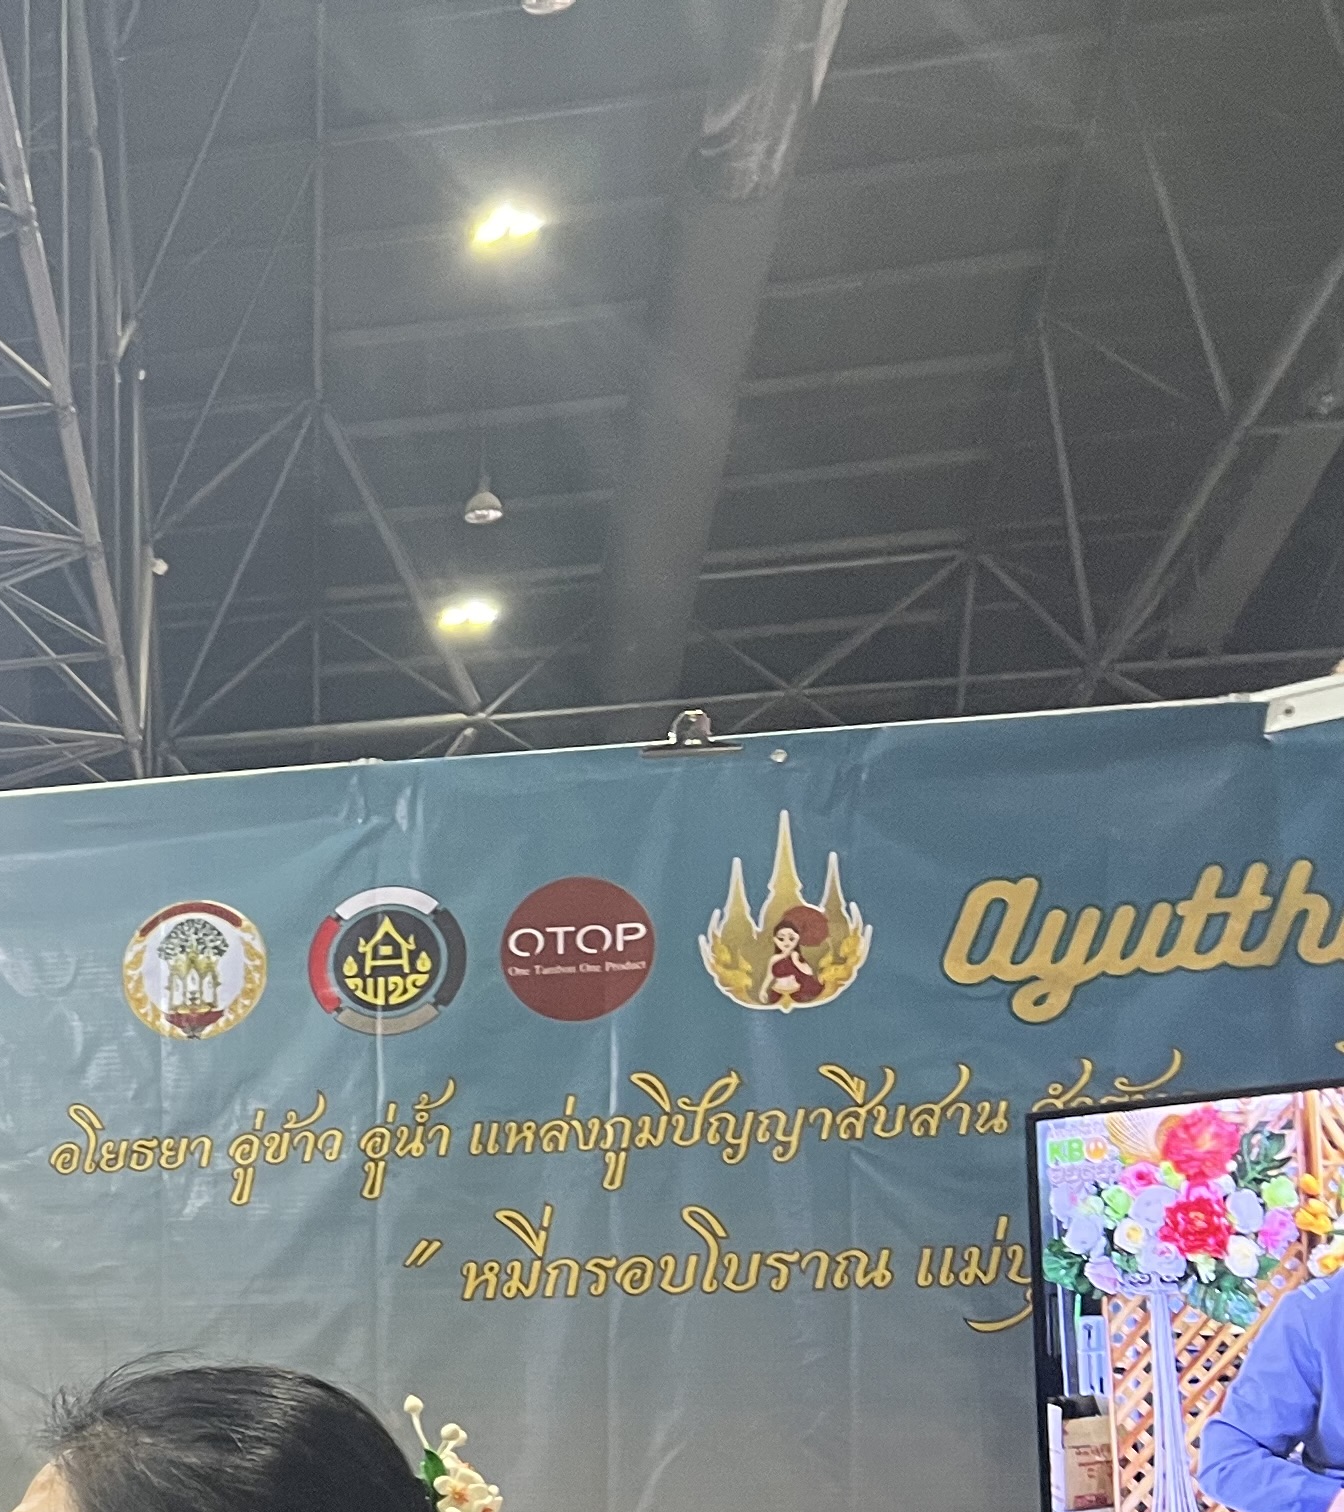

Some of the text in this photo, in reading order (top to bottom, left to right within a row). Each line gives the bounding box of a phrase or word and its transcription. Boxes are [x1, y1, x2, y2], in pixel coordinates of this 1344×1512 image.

[507, 922, 648, 957] OTOP
[941, 858, 1344, 1024] Ayutth
[48, 1102, 213, 1175] อโยธยา
[228, 1089, 344, 1207] อู่ข้าว
[358, 1077, 456, 1200] อู่น้ำ
[467, 1062, 1011, 1191] แหล่งภูมิปัญญาสืบสาน
[460, 1202, 894, 1301] หมี่กรอบโบราณ
